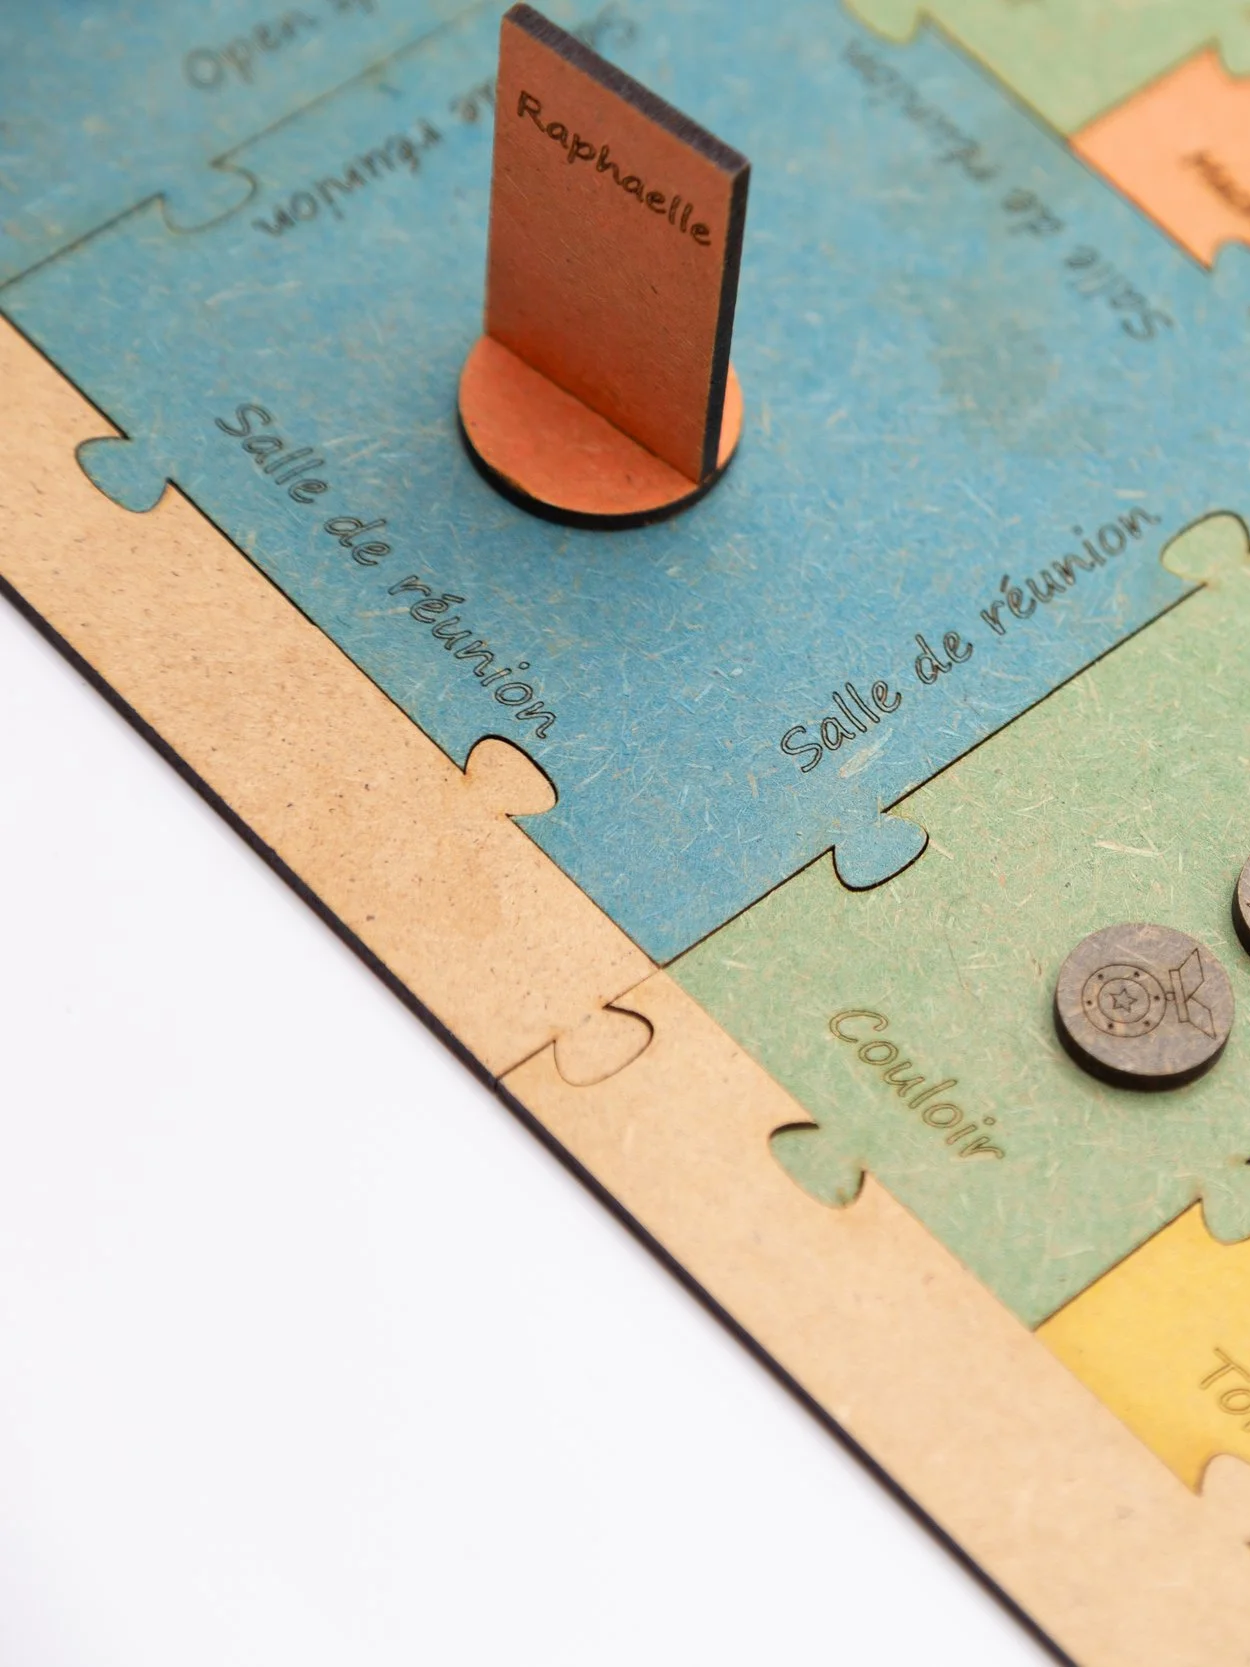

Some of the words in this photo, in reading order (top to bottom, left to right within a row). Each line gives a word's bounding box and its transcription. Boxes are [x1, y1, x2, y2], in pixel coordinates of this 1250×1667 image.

[516, 89, 712, 246] Raphaelle
[1060, 246, 1176, 341] Salle
[214, 402, 329, 504] Salle
[323, 516, 392, 567] de
[388, 575, 557, 740] réunion
[779, 680, 902, 773] Salle
[914, 631, 974, 685] de
[980, 505, 1162, 636] réunion
[828, 1009, 1006, 1160] Couloir
